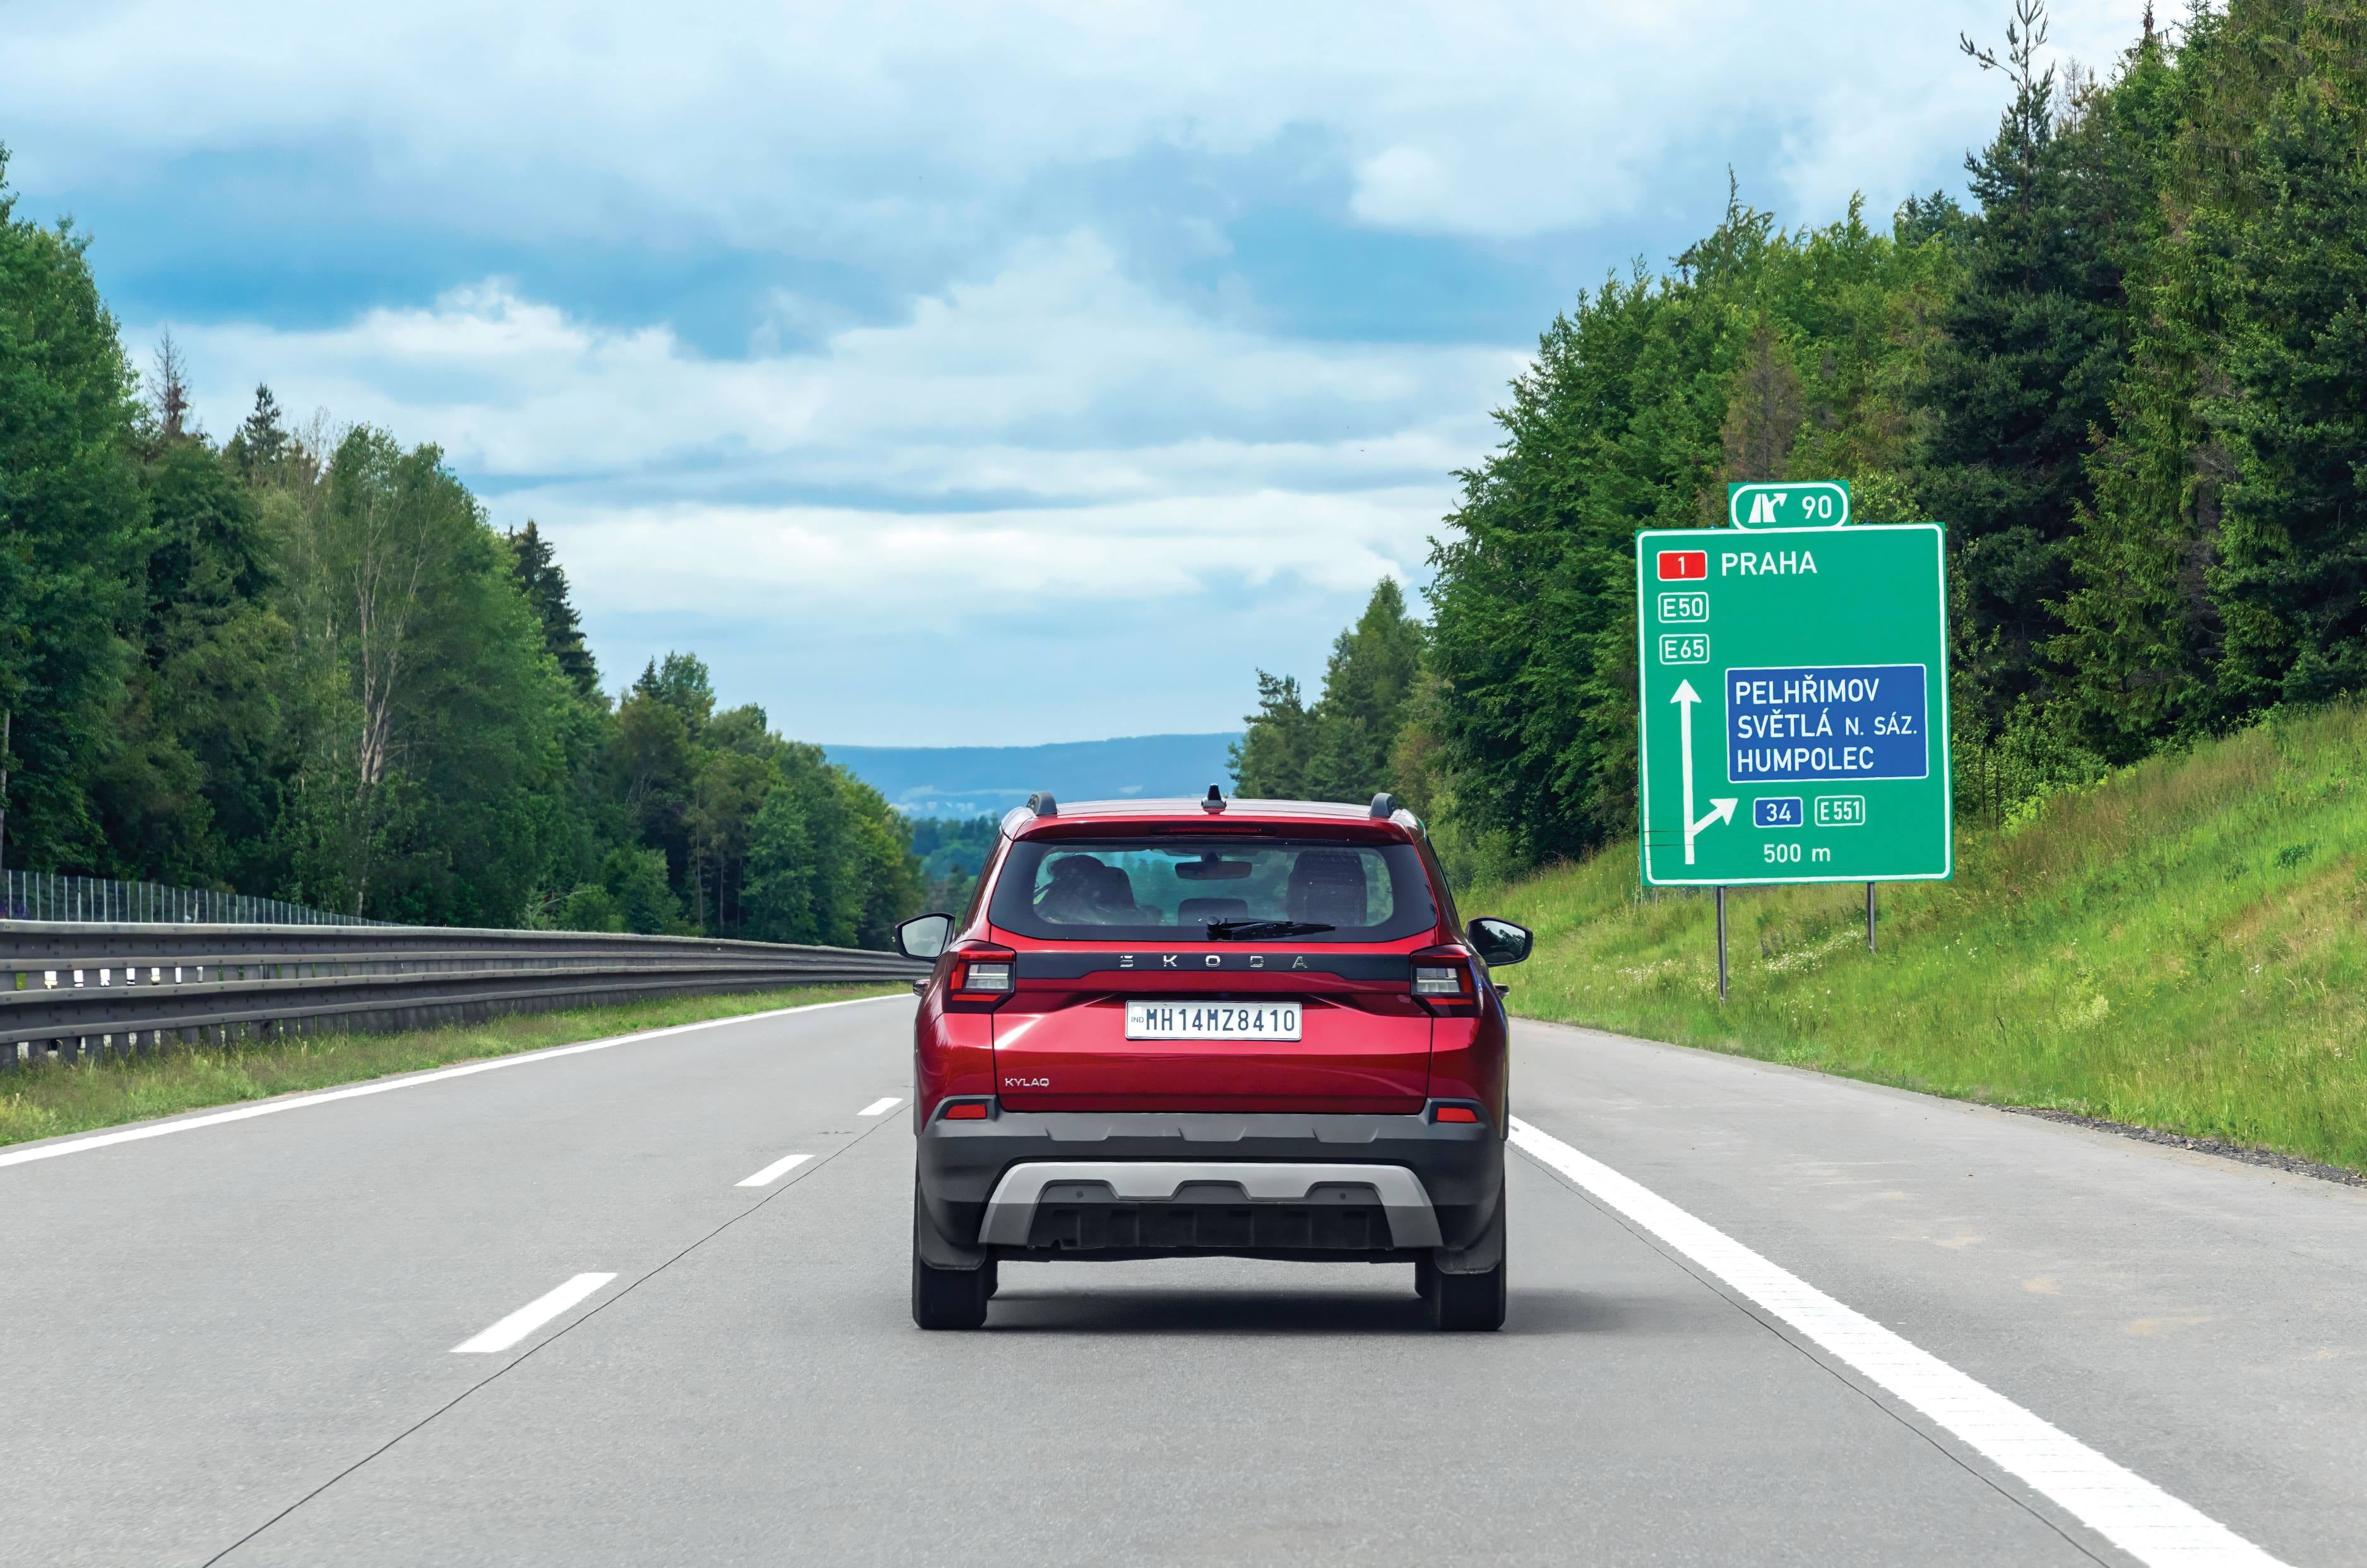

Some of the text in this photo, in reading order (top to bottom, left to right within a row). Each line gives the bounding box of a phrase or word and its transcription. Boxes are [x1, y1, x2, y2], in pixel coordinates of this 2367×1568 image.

[1802, 496, 1832, 520] 90
[1677, 556, 1685, 575] 1
[1722, 551, 1817, 576] PRAHA
[1663, 598, 1703, 617] E50
[1664, 640, 1704, 658] E65
[1736, 675, 1879, 704] PELHŘIMOV
[1738, 708, 1917, 739] SVĚTLÁ N. SÁZ.
[1738, 746, 1874, 773] HUMPOLEC
[1766, 804, 1791, 822] 34
[1764, 844, 1830, 863] 500 m
[1146, 1009, 1295, 1031] MH14MZ8410
[1005, 1078, 1050, 1088] KYLAQ
